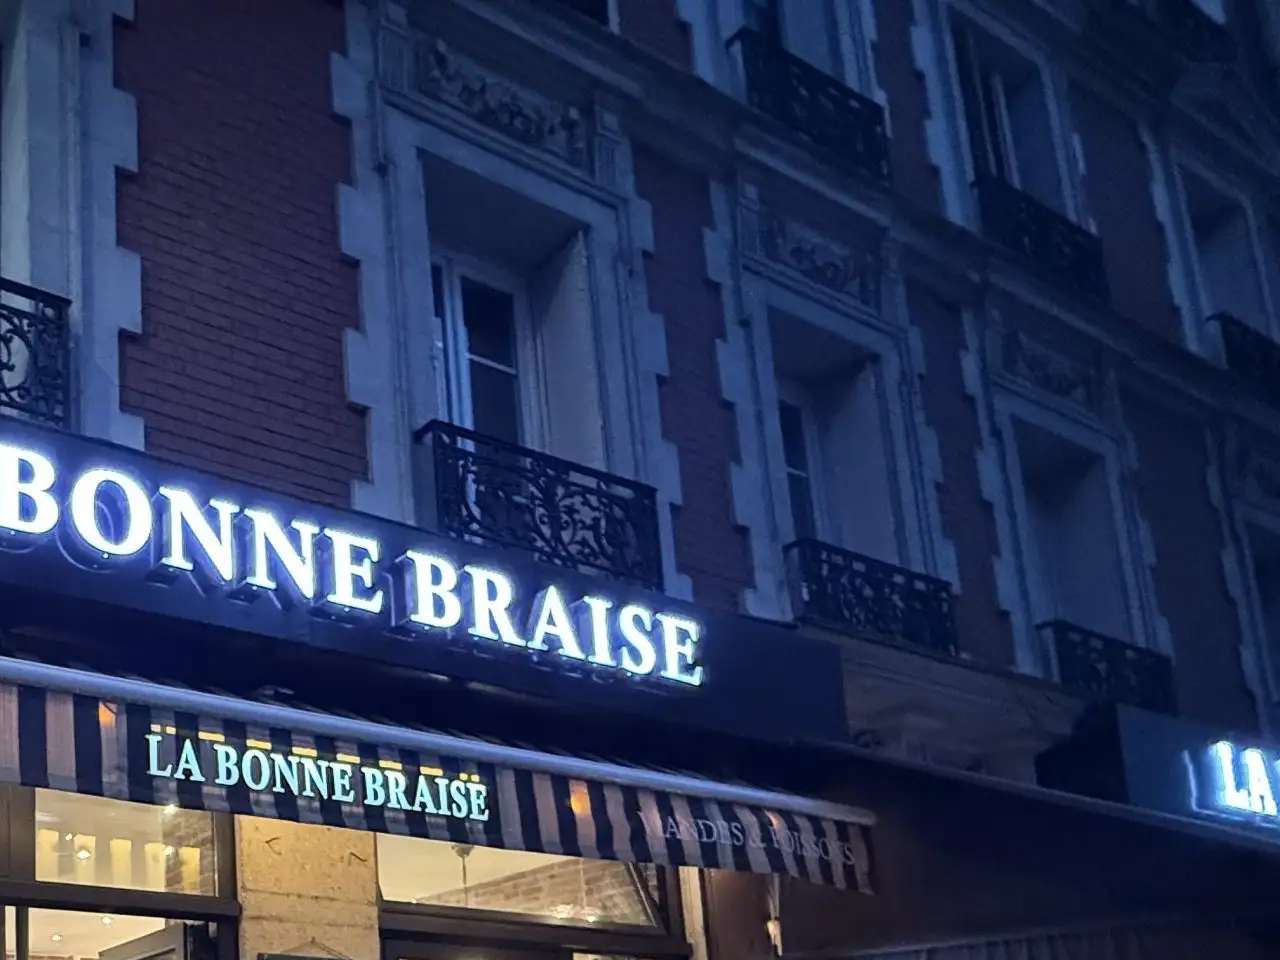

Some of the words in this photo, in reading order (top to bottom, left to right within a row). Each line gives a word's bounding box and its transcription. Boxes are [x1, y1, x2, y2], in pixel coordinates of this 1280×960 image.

[406, 550, 704, 686] BRAISE
[145, 734, 205, 783] LA
[213, 744, 355, 803] BONNE
[361, 766, 490, 822] BRAISE
[1214, 740, 1278, 816] LA
